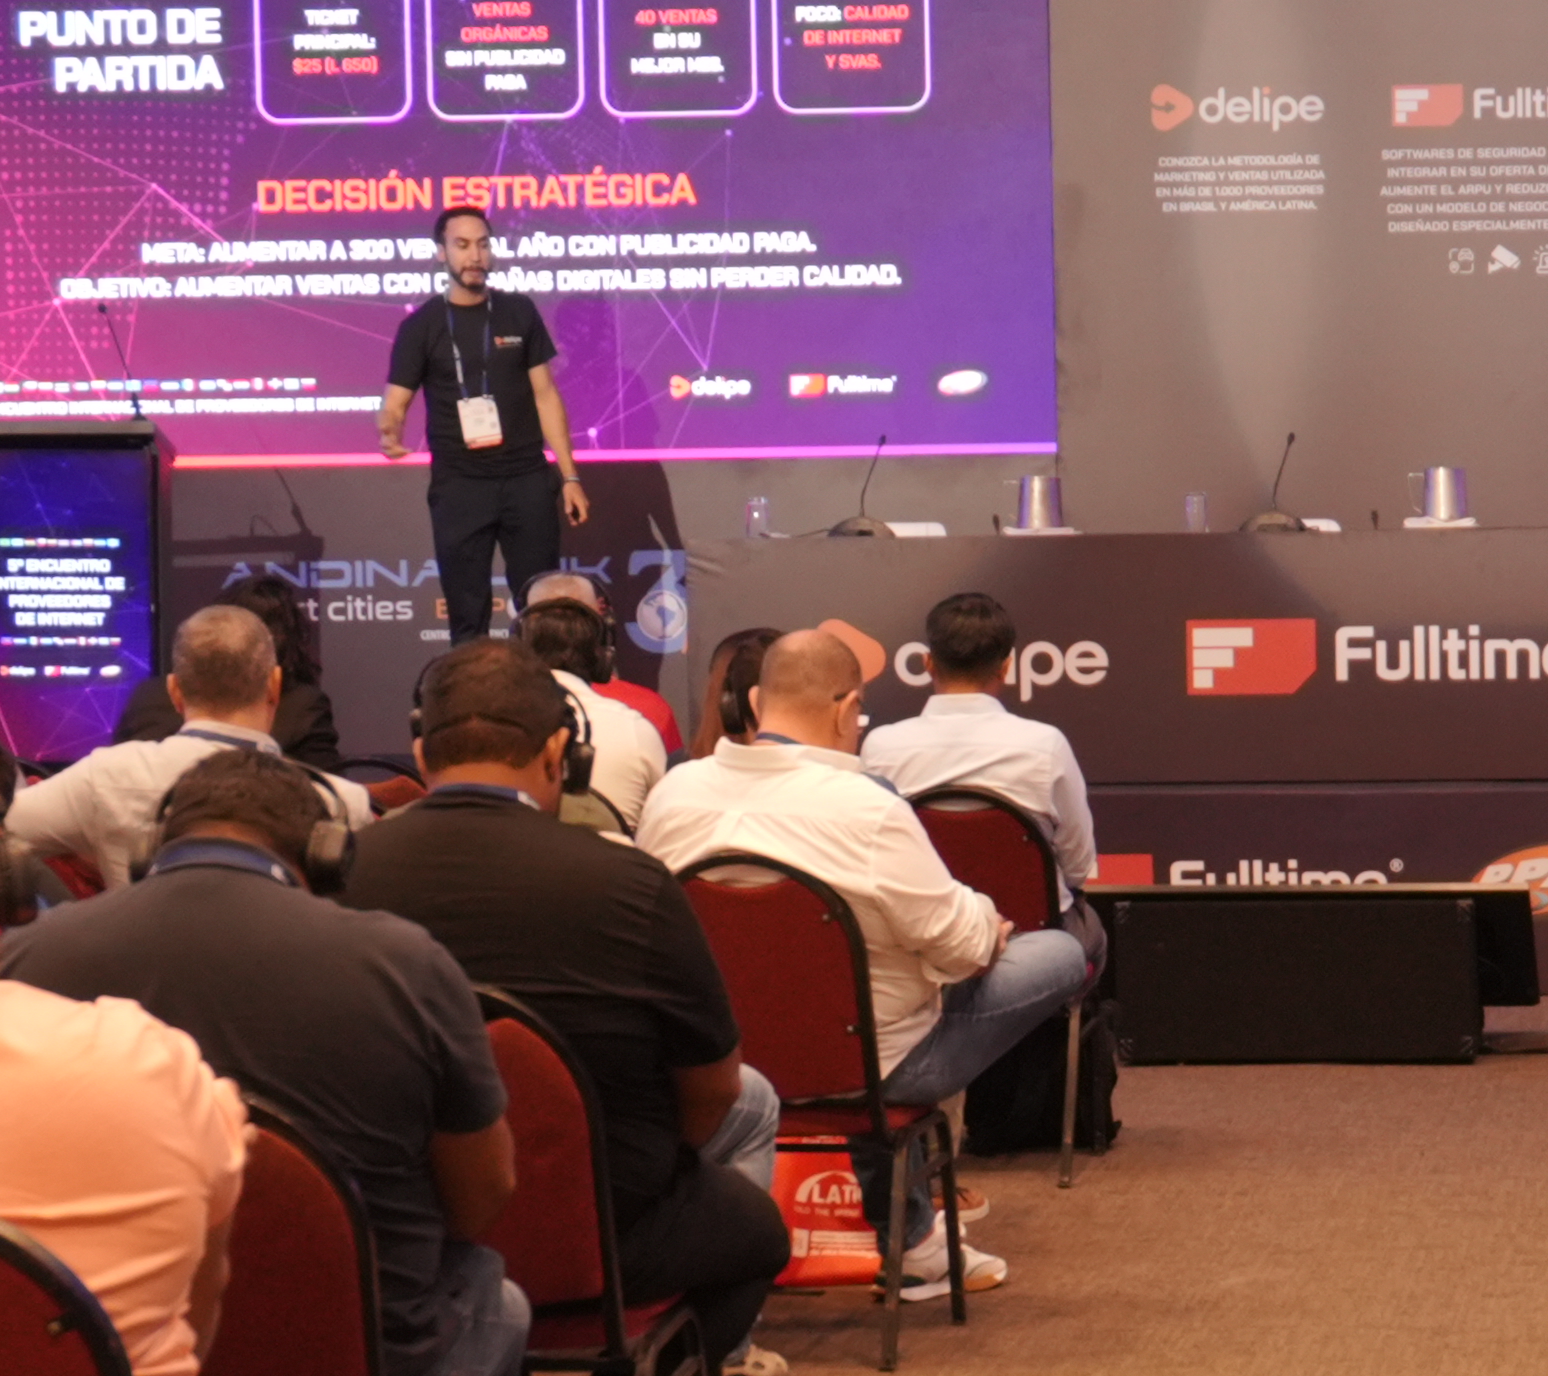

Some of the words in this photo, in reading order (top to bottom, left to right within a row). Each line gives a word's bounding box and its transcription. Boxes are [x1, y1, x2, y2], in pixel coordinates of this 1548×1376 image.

[17, 9, 157, 48] PUNTO
[166, 7, 222, 44] DE
[54, 55, 224, 93] PARTIDA
[1199, 86, 1324, 132] delipe
[1159, 156, 1209, 167] CONOZCA
[1212, 156, 1226, 166] LA
[1227, 153, 1303, 166] METODOLOGÍA
[1306, 154, 1320, 164] DE
[1382, 149, 1454, 160] SOFTWARES
[1458, 148, 1474, 159] DE
[1477, 147, 1546, 159] SEGURIDAD
[1154, 171, 1216, 182] MARKETING
[1218, 171, 1226, 181] Y
[1227, 171, 1269, 181] VENTAS
[1271, 169, 1325, 180] UTILIZADA
[1387, 167, 1447, 178] INTEGRAR
[1451, 166, 1467, 177] EN
[1470, 166, 1486, 176] SU
[1489, 165, 1536, 176] OFERTA
[257, 169, 432, 213] DECISIÓN
[442, 166, 698, 209] ESTRATÉGICA
[1156, 187, 1171, 197] EN
[1173, 185, 1195, 196] MÁS
[1198, 186, 1212, 196] DE
[1245, 185, 1324, 195] PROVEEDORES
[1380, 185, 1437, 196] AUMENTE
[1441, 185, 1455, 195] EL
[1458, 184, 1492, 195] ARPU
[1494, 184, 1502, 194] Y
[1163, 202, 1177, 212] EN
[1179, 201, 1217, 212] BRASIL
[1219, 201, 1227, 210] Y
[1229, 199, 1276, 211] AMÉRICA
[1278, 200, 1317, 210] LATINA.
[1387, 203, 1413, 215] CON
[1416, 203, 1433, 214] UN
[1437, 202, 1487, 214] MODELO
[1490, 202, 1506, 213] DE
[1388, 219, 1449, 232] DISEÑADO
[327, 595, 414, 621] cities
